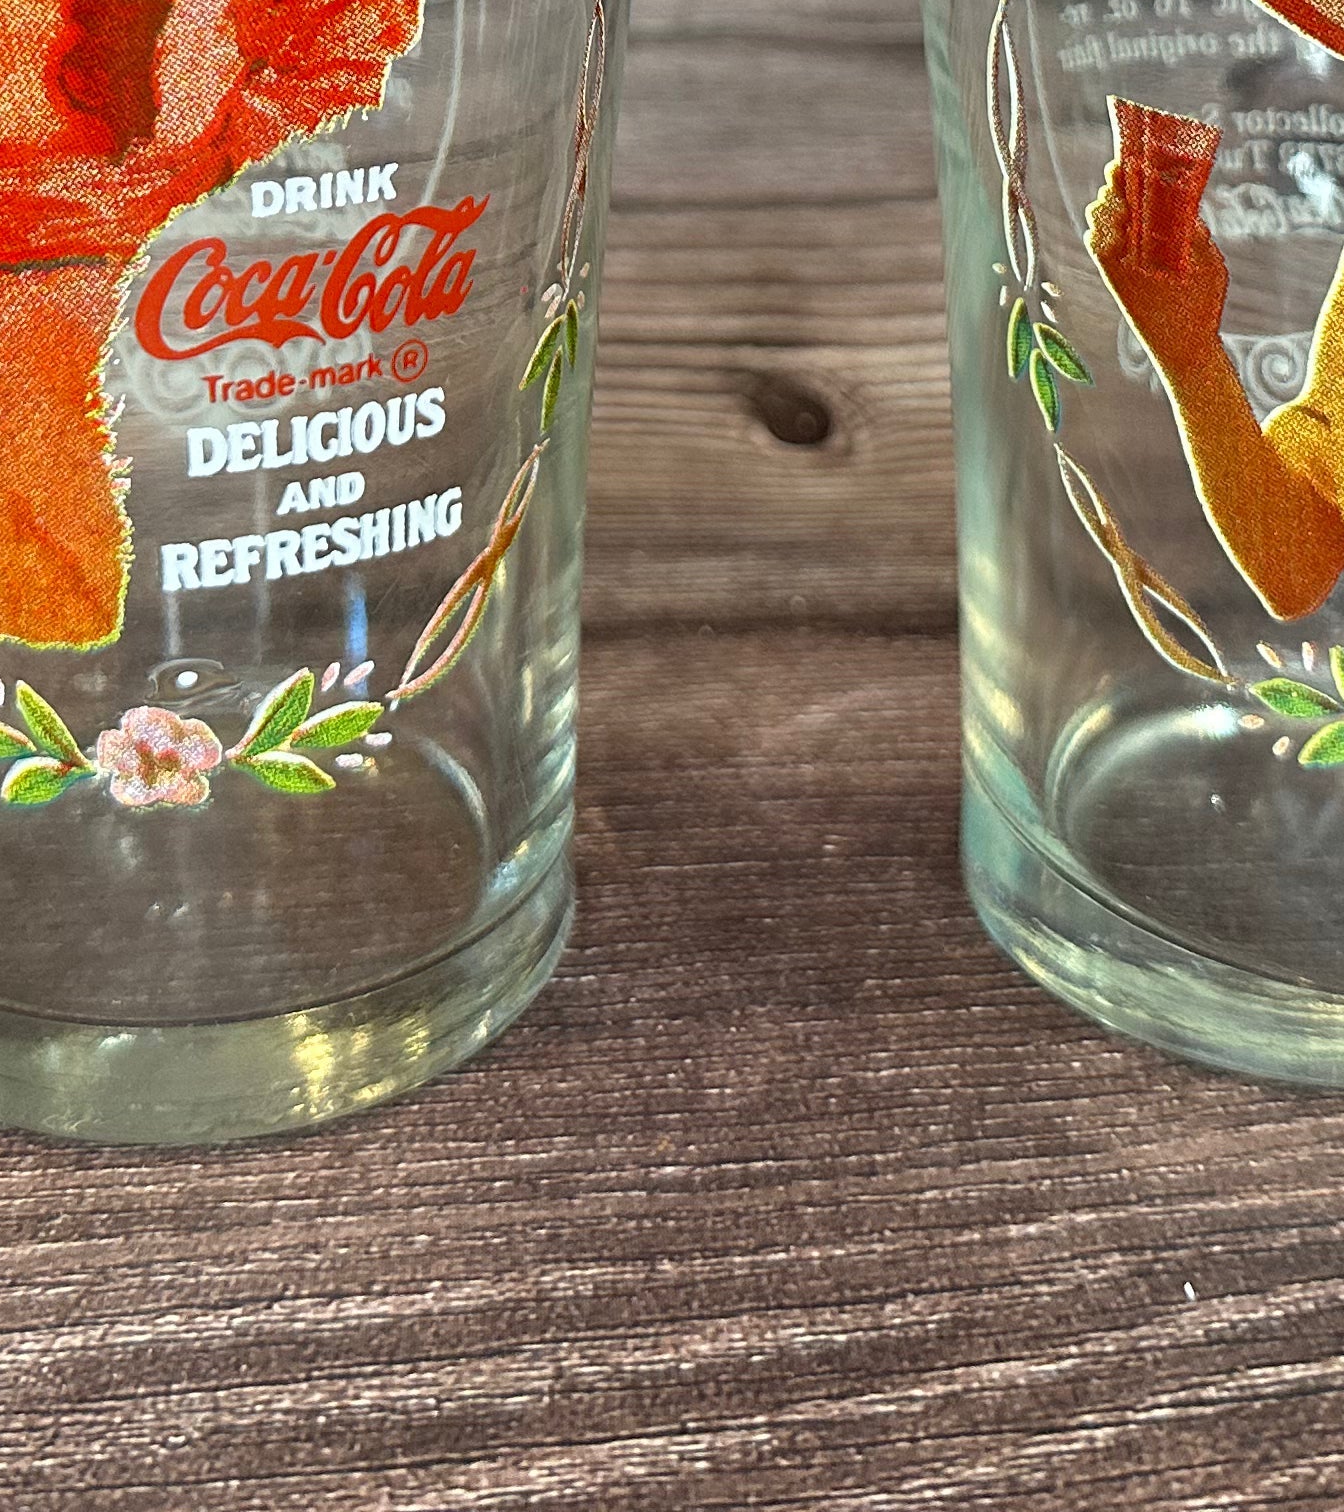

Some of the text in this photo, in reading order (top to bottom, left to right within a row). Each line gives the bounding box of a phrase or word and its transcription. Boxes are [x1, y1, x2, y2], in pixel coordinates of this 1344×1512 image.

[250, 162, 399, 218] DRINK
[134, 193, 490, 361] Coca-Cola
[201, 358, 383, 404] Trade-mark
[186, 387, 447, 478] DELICIOUS
[275, 470, 366, 516] AND
[159, 486, 464, 592] REFRESHING
